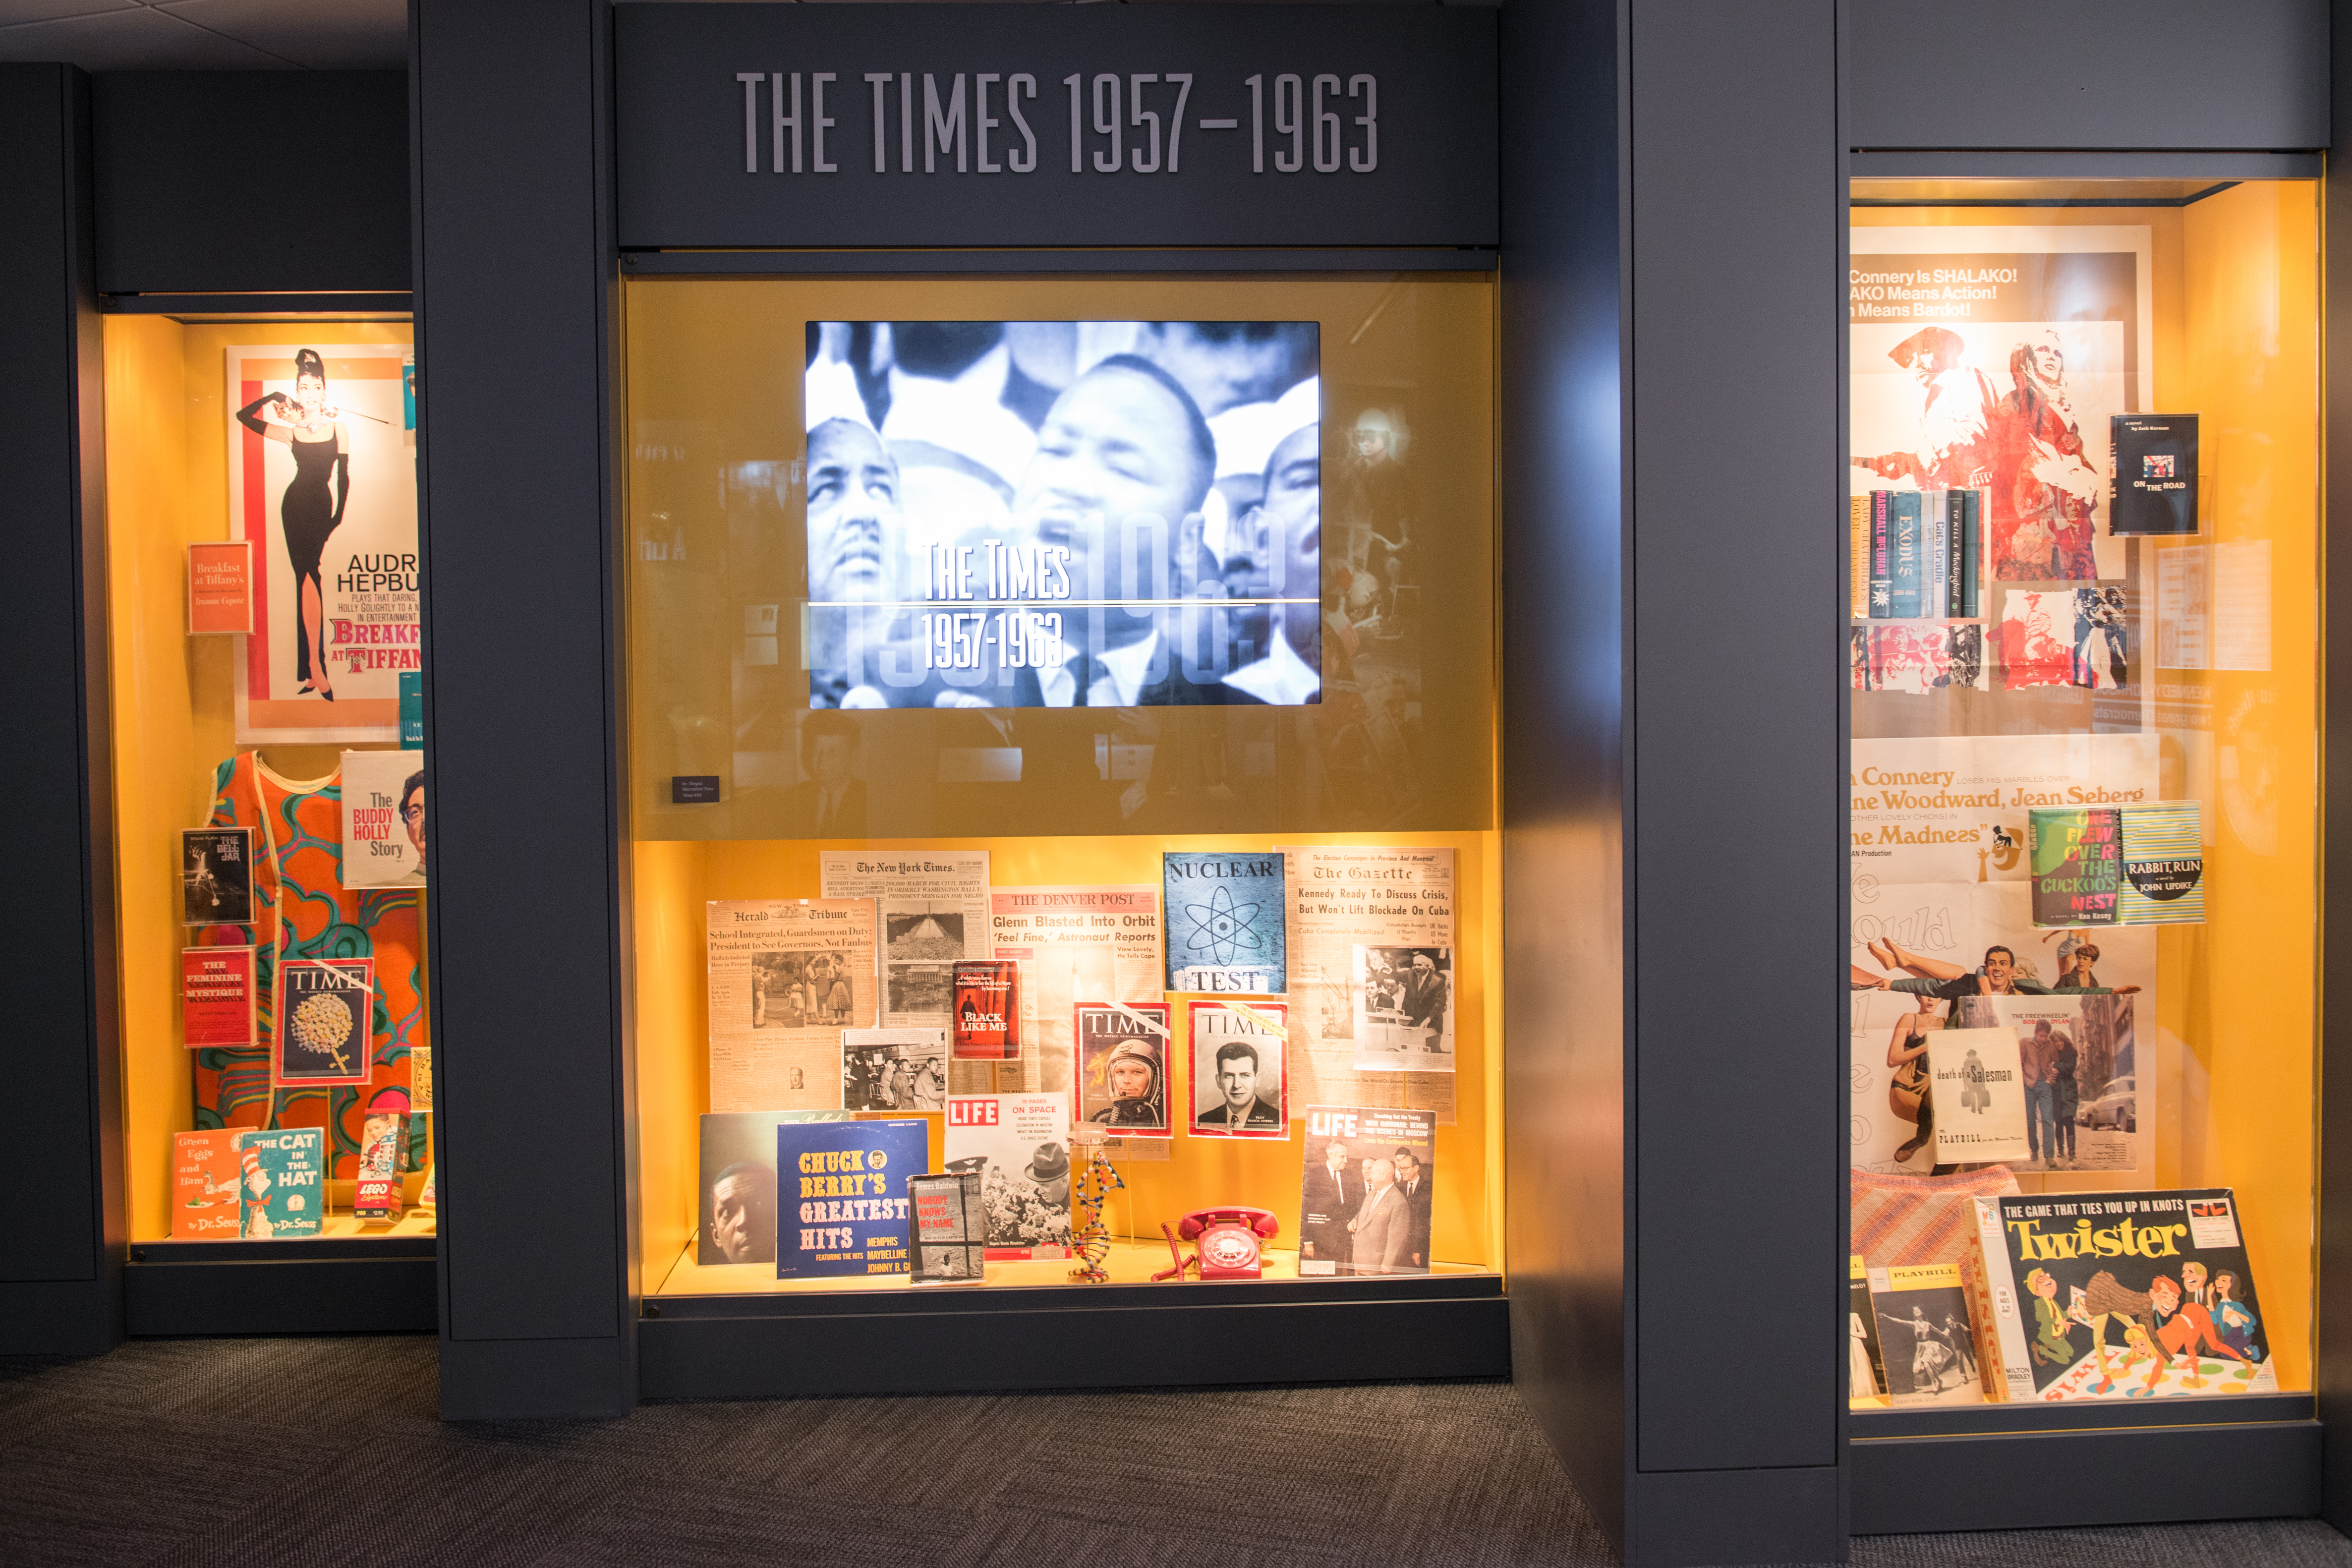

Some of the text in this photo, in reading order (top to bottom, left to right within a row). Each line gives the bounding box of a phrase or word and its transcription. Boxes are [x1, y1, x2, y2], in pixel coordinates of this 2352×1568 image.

[737, 72, 838, 174] THE
[864, 72, 1037, 174] TIMES
[1850, 268, 2017, 286] Connery Is SHALAKO!
[1888, 286, 1940, 300] Means
[1941, 285, 1997, 300] Action!
[1858, 302, 1971, 317] Means Bardot!
[1876, 490, 1887, 534] MARSHALL
[1898, 515, 1914, 578] EXODUS
[1935, 521, 1945, 584] Cat's Cradle
[197, 562, 240, 574] Breakfast
[347, 554, 417, 573] AUDR
[920, 538, 1071, 599] THE TIMES
[194, 573, 244, 586] at Tiffany's
[338, 573, 420, 592] HEPBU
[329, 618, 421, 645] BREAKF
[920, 611, 1063, 670] 1957-1963
[1862, 766, 1955, 788] Connery
[370, 792, 393, 808] The
[1880, 787, 2062, 810] Woodward, Jean
[353, 808, 394, 824] BUDDY
[2076, 810, 2113, 826] ONE
[220, 835, 239, 845] THE
[353, 824, 391, 841] HOLLY
[2066, 826, 2114, 843] FLEW
[217, 844, 239, 853] BELL
[370, 840, 403, 859] Story
[2064, 843, 2116, 862] OVER
[221, 852, 241, 862] JAR
[857, 861, 875, 874] The
[876, 862, 897, 873] New
[898, 862, 922, 875] York
[923, 861, 955, 872] Times.
[1169, 861, 1275, 879] NUCLEAR
[1313, 867, 1413, 879] The Gazette
[2078, 859, 2115, 876] THE
[2128, 860, 2201, 874] RABBIT, RUN
[2040, 874, 2117, 894] CUCKOO'S
[2139, 881, 2193, 893] JOHN UPDIKE
[1011, 893, 1135, 906] THE DENVER POST
[1298, 888, 1448, 901] Kennedy Ready To Discuss Crisis,
[2070, 893, 2117, 911] NEST
[734, 909, 848, 923] Herald Tribune
[993, 915, 1156, 928] Glenn Blasted Into Orbit
[709, 929, 738, 940] School
[739, 928, 786, 941] Integrated,
[787, 928, 835, 938] Guardsmen
[1057, 931, 1156, 943] Astronaut Reports
[202, 961, 227, 970] THE
[186, 974, 242, 983] FEMININE
[290, 970, 361, 990] TIME
[1191, 971, 1260, 991] TEST
[186, 988, 243, 997] MYSTIQUE
[965, 1011, 1003, 1022] BLACK
[1085, 1013, 1159, 1035] TIME
[960, 1022, 1007, 1032] LIKE ME
[1937, 1067, 1956, 1080] death
[1958, 1067, 1964, 1079] of
[1971, 1065, 2012, 1083] Salesman
[950, 1102, 997, 1124] LIFE
[1312, 1112, 1358, 1138] LIFE
[178, 1137, 210, 1147] Green
[254, 1133, 316, 1150] THE CAT
[1939, 1134, 1981, 1144] PLAYBILL
[187, 1149, 214, 1161] Eggs
[291, 1151, 305, 1160] IN
[798, 1150, 865, 1174] CHUCK
[179, 1163, 200, 1173] and
[287, 1161, 309, 1170] THE
[179, 1176, 204, 1186] Ham
[278, 1170, 318, 1188] HAT
[799, 1172, 887, 1199] BERRY'S
[359, 1183, 388, 1195] LEGO
[917, 1195, 948, 1206] NOBODY
[799, 1197, 910, 1224] GREATEST
[918, 1207, 946, 1217] KNOWS
[2004, 1199, 2184, 1219] THE GAME THAT TIES YOU UP IN KNOTS
[280, 1218, 317, 1231] Dr. Seuss
[919, 1218, 954, 1229] MY NAME
[799, 1226, 854, 1251] HITS
[2006, 1217, 2187, 1262] Twister
[1893, 1269, 1956, 1278] PLAYBILL
